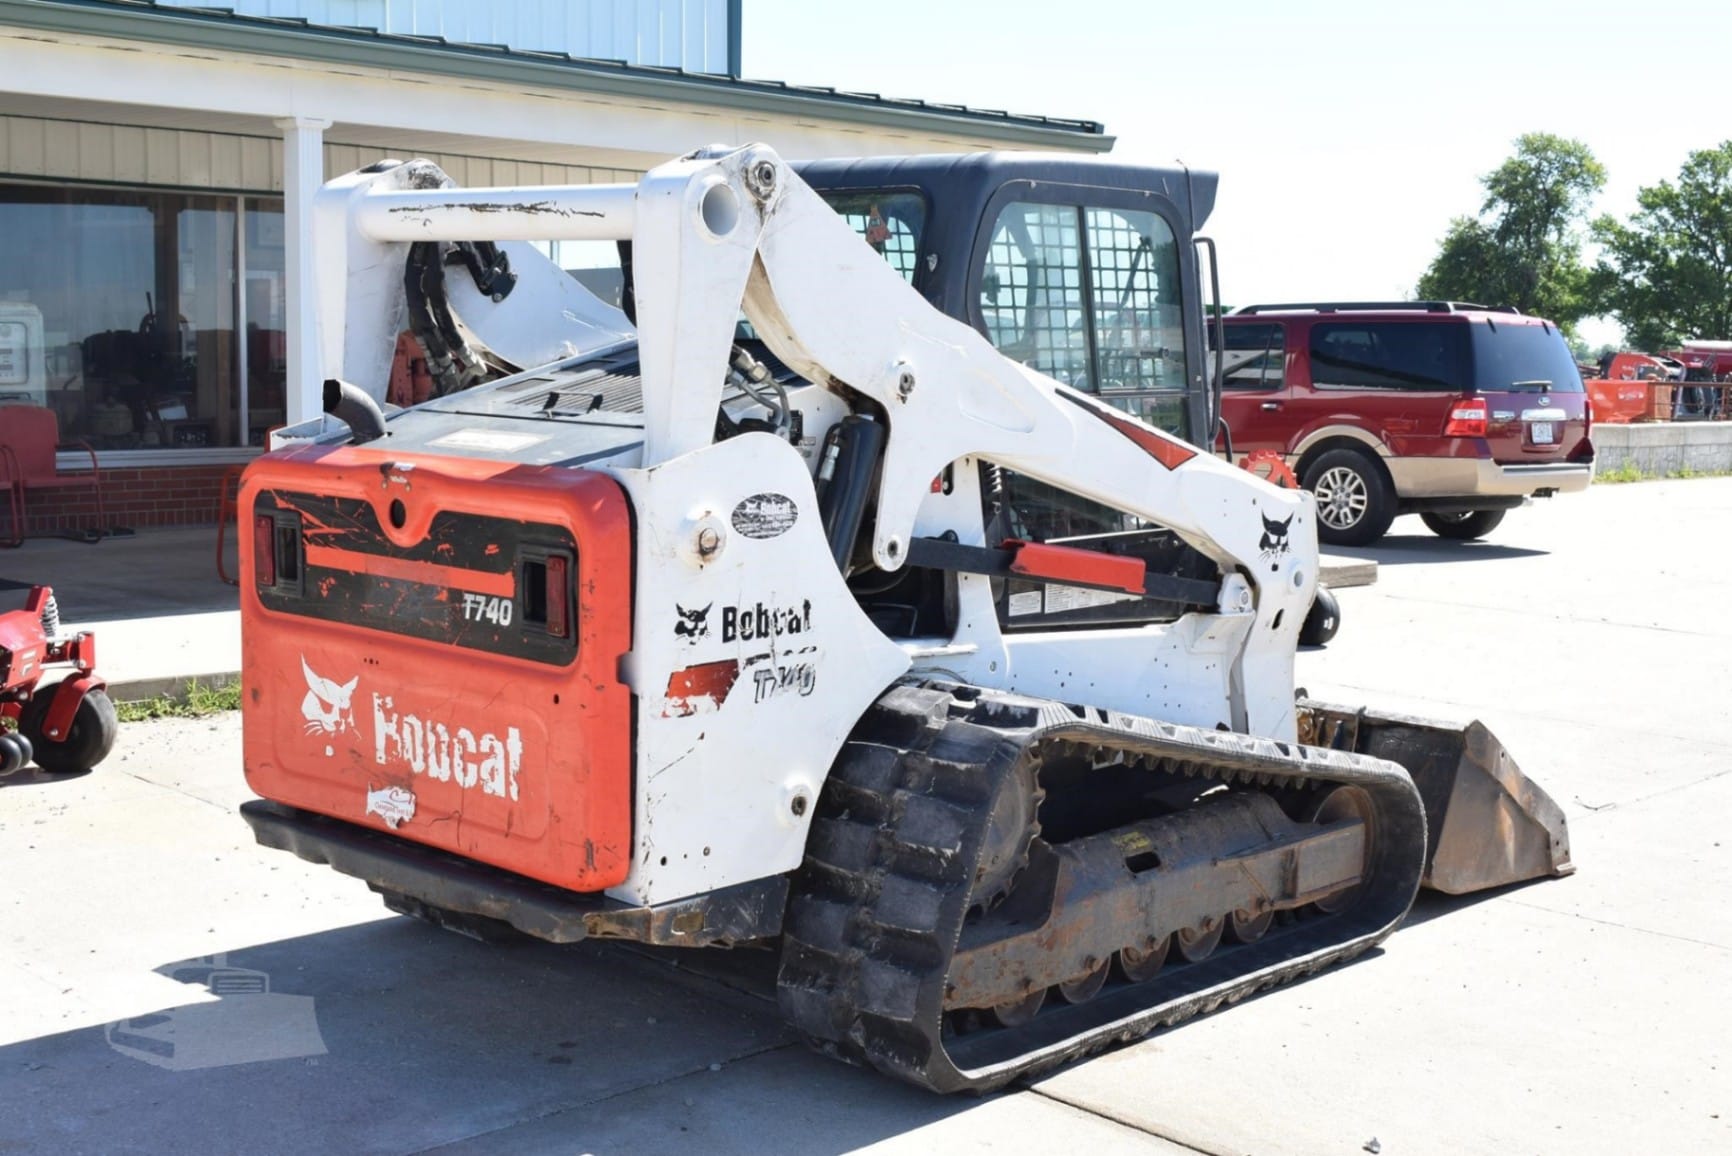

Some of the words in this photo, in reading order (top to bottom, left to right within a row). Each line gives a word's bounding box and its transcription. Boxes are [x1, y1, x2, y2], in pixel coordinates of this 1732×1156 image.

[463, 592, 513, 627] T740
[722, 598, 811, 643] Bobcat
[372, 692, 523, 802] Bobcat
